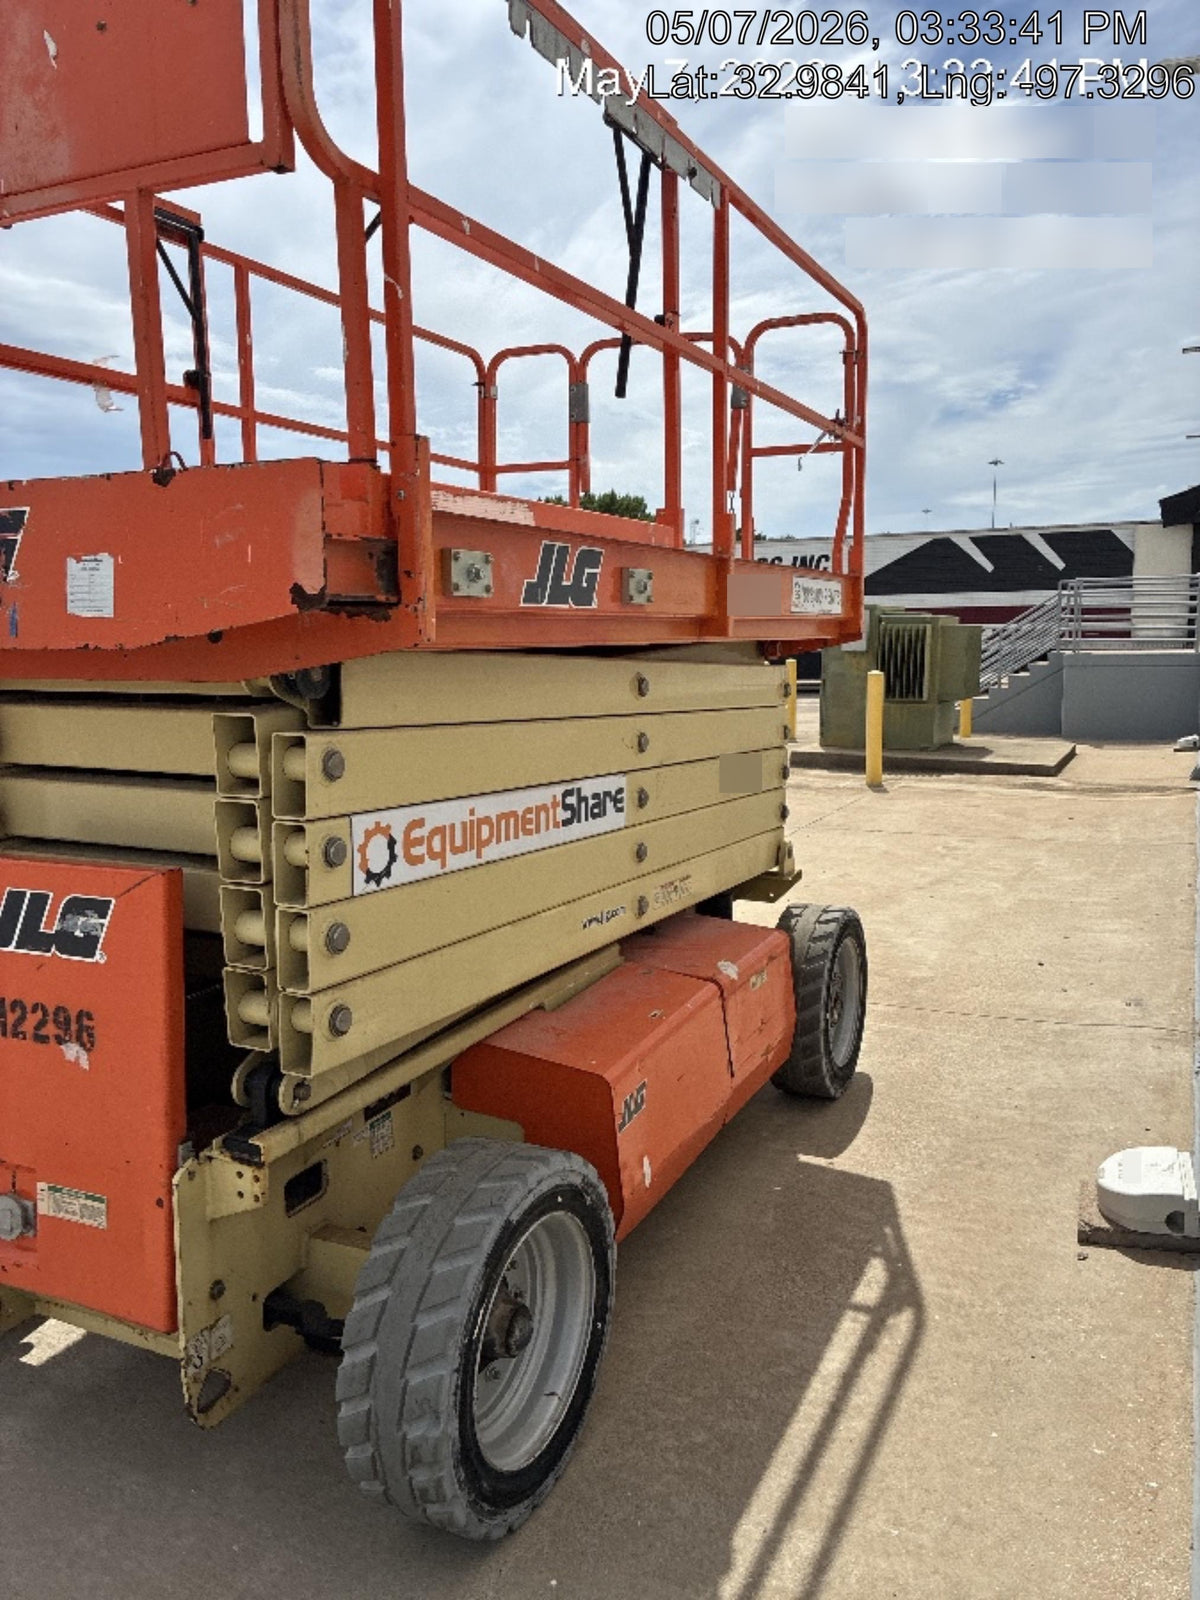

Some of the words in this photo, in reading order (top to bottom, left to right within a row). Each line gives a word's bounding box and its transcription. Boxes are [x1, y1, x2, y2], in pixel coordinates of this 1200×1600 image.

[519, 540, 605, 609] JLG
[402, 786, 625, 870] EquipmentShare
[617, 1078, 648, 1134] JLG
